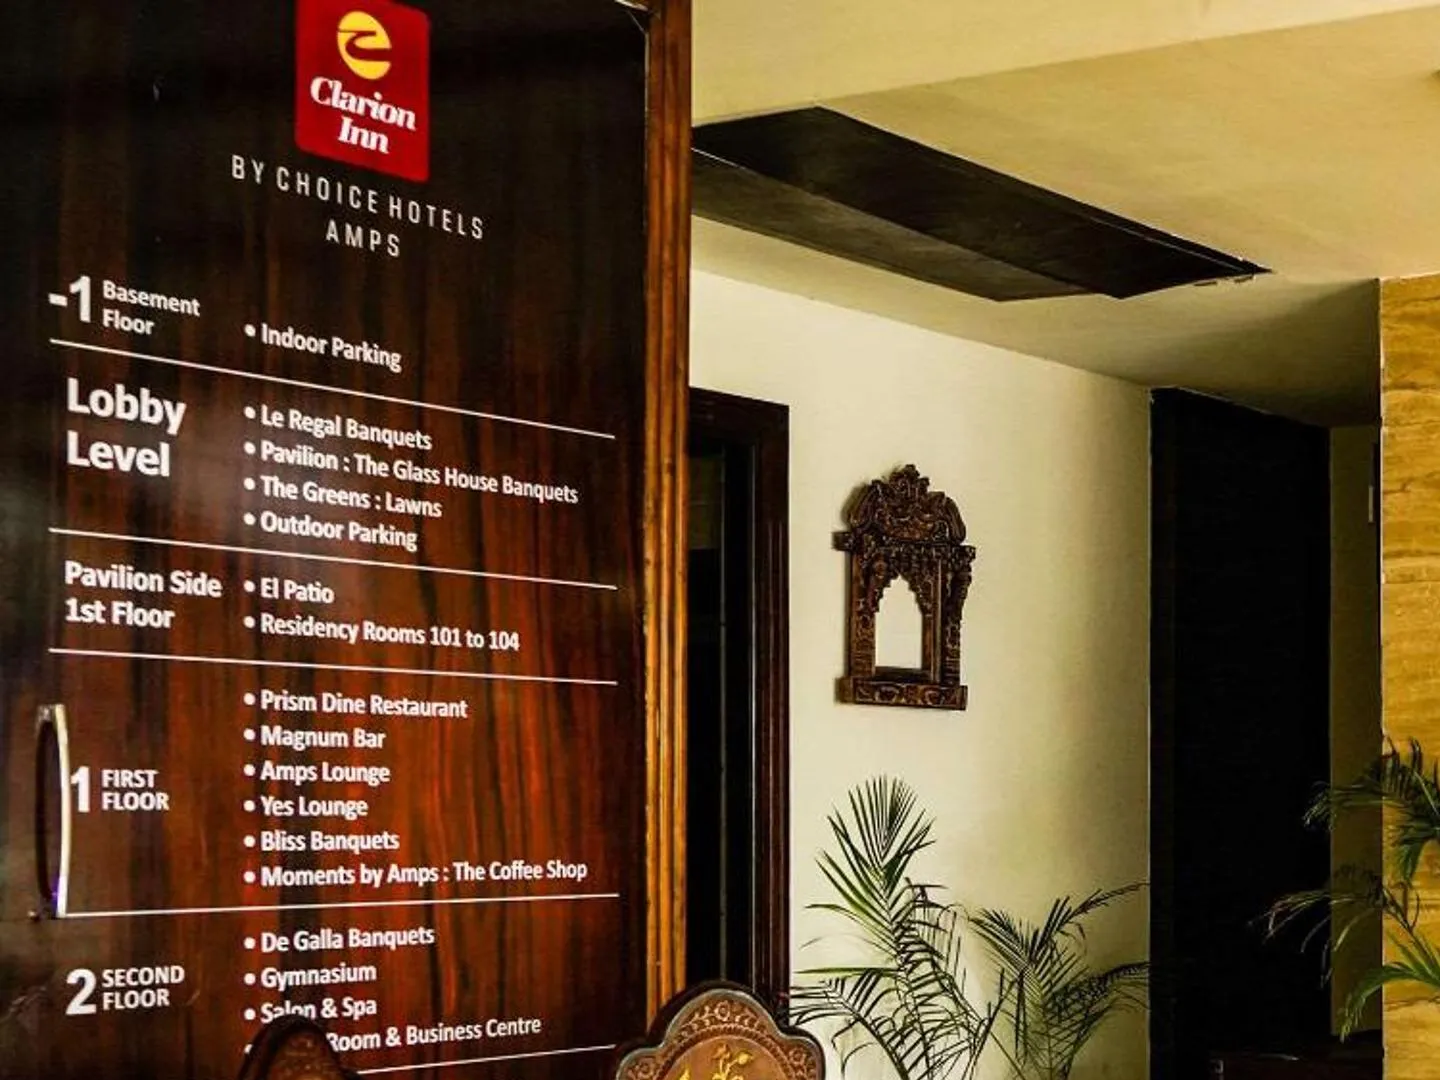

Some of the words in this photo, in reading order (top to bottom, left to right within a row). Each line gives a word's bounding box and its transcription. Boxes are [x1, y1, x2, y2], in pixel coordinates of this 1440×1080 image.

[310, 76, 416, 131] Clarion
[338, 115, 388, 154] Inn
[232, 155, 264, 183] BY
[277, 167, 377, 213] CHOICE
[389, 194, 482, 239] HOTELS
[326, 220, 399, 256] AMPS
[49, 276, 90, 322] -1
[103, 280, 200, 317] Basement
[103, 309, 154, 334] Floor
[262, 323, 328, 354] Indoor
[332, 337, 401, 373] Parking
[67, 378, 186, 436] Lobby
[261, 404, 284, 428] Le
[289, 409, 341, 439] Regal
[346, 418, 432, 450] Banquets
[68, 430, 170, 477] Level
[261, 440, 338, 471] Pavilion
[353, 453, 389, 477] The
[393, 460, 440, 484] Glass
[445, 467, 498, 492] House
[503, 476, 578, 503] Banquets
[260, 475, 299, 500] The
[302, 481, 370, 509] Greens
[386, 492, 442, 517] Lawns
[260, 511, 345, 540] Outdoor
[348, 521, 417, 552] Parking
[65, 560, 164, 592] Pavilion
[170, 570, 222, 597] Side
[261, 577, 279, 599] El
[284, 580, 334, 603] Patio
[66, 598, 106, 624] 1st
[112, 601, 175, 628] Floor
[261, 613, 359, 644] Residency
[363, 621, 426, 644] Rooms
[430, 627, 462, 647] 101
[465, 630, 484, 648] to
[489, 631, 519, 651] 104
[261, 689, 317, 711] Prism
[322, 693, 366, 714] Dine
[370, 695, 468, 718] Restaurant
[261, 725, 349, 751] Magnum
[353, 728, 386, 748] Bar
[71, 766, 89, 812] 1
[102, 769, 158, 788] FIRST
[260, 761, 317, 785] Amps
[322, 762, 390, 786] Lounge
[102, 792, 169, 810] FLOOR
[260, 796, 294, 816] Yes
[299, 796, 368, 820] Lounge
[261, 830, 306, 851] Bliss
[311, 831, 399, 854] Banquets
[261, 866, 355, 886] Moments
[360, 864, 384, 888] by
[387, 864, 439, 886] Amps
[453, 862, 486, 881] The
[489, 860, 543, 880] Coffee
[547, 860, 587, 881] Shop
[261, 933, 289, 952] De
[294, 928, 343, 951] Galla
[349, 927, 434, 950] Banquets
[66, 969, 96, 1015] 2
[102, 966, 184, 987] SECOND
[261, 962, 376, 991] Gymnasium
[103, 989, 169, 1010] FLOOR
[321, 998, 338, 1018] &
[342, 997, 376, 1020] Spa
[385, 1027, 401, 1047] &
[406, 1023, 482, 1045] Business
[486, 1018, 541, 1037] Centre
